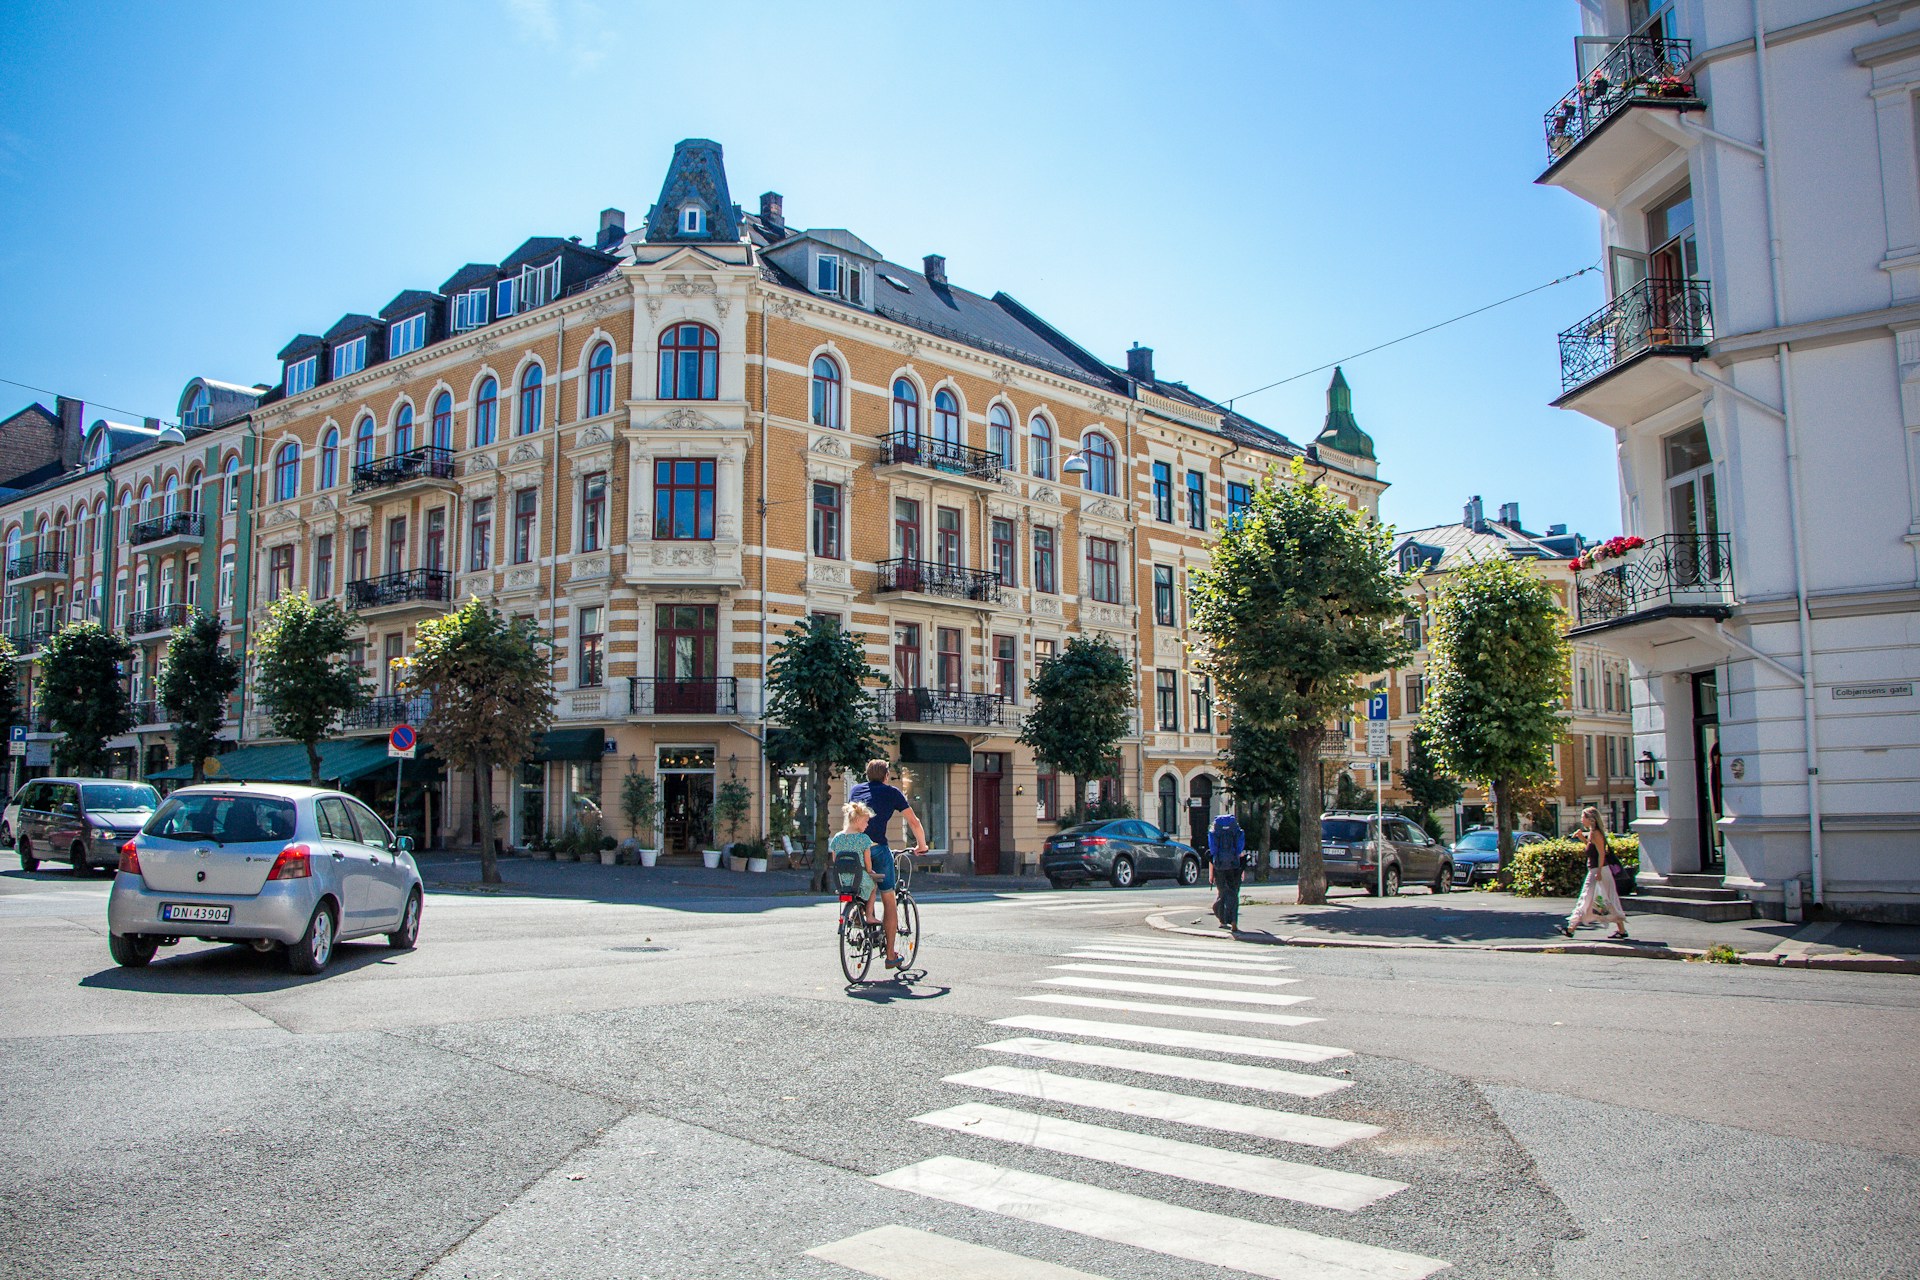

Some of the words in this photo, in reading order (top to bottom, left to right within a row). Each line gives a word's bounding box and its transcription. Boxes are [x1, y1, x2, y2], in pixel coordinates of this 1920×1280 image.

[1836, 688, 1886, 697] Colbjørnsens
[1890, 687, 1908, 695] gate
[1373, 697, 1384, 717] P
[14, 728, 23, 740] P
[173, 907, 189, 918] DN
[193, 909, 228, 920] 43904
